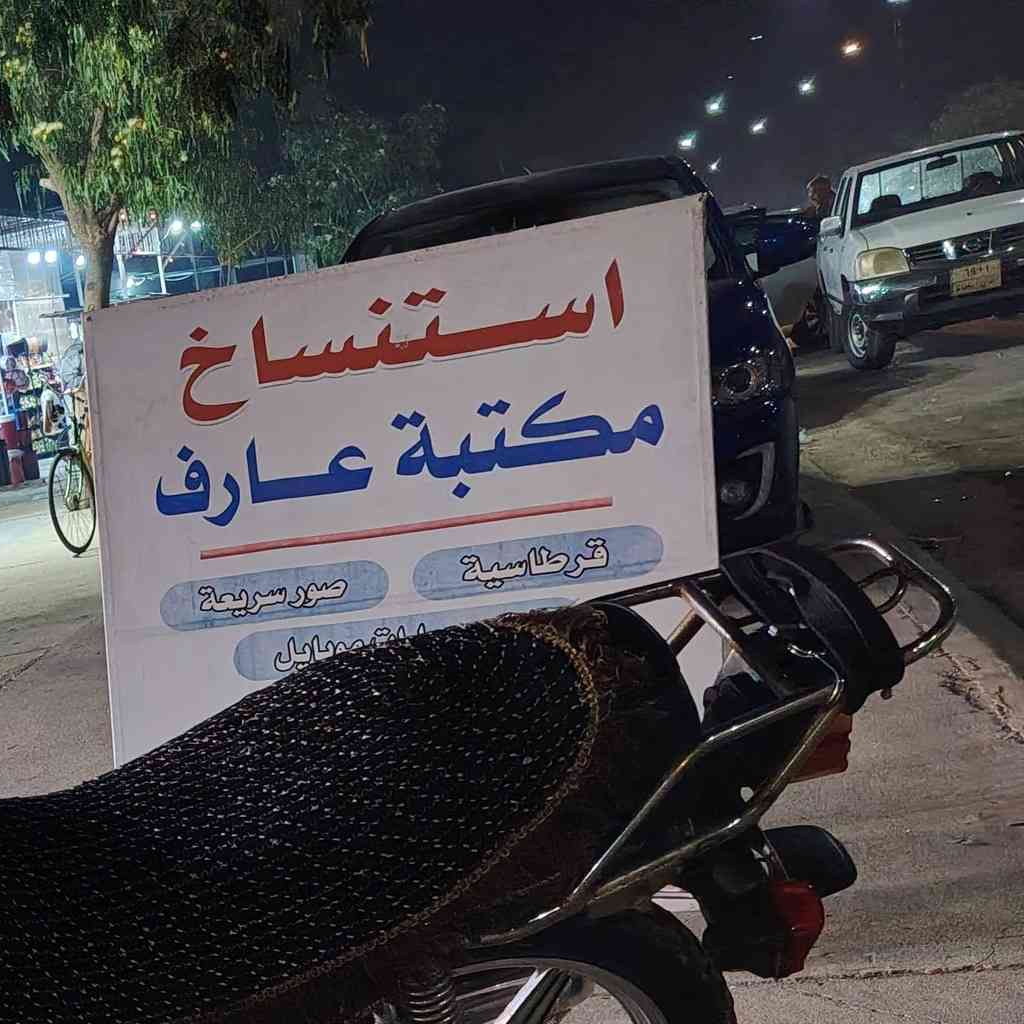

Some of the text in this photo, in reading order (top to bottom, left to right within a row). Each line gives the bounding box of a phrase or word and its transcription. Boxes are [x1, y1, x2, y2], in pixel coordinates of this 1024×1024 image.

[179, 257, 624, 423] استنساخ
[154, 390, 664, 527] مكتبة عارف
[197, 578, 349, 617] صور سريعة
[460, 537, 610, 590] قرطاسية
